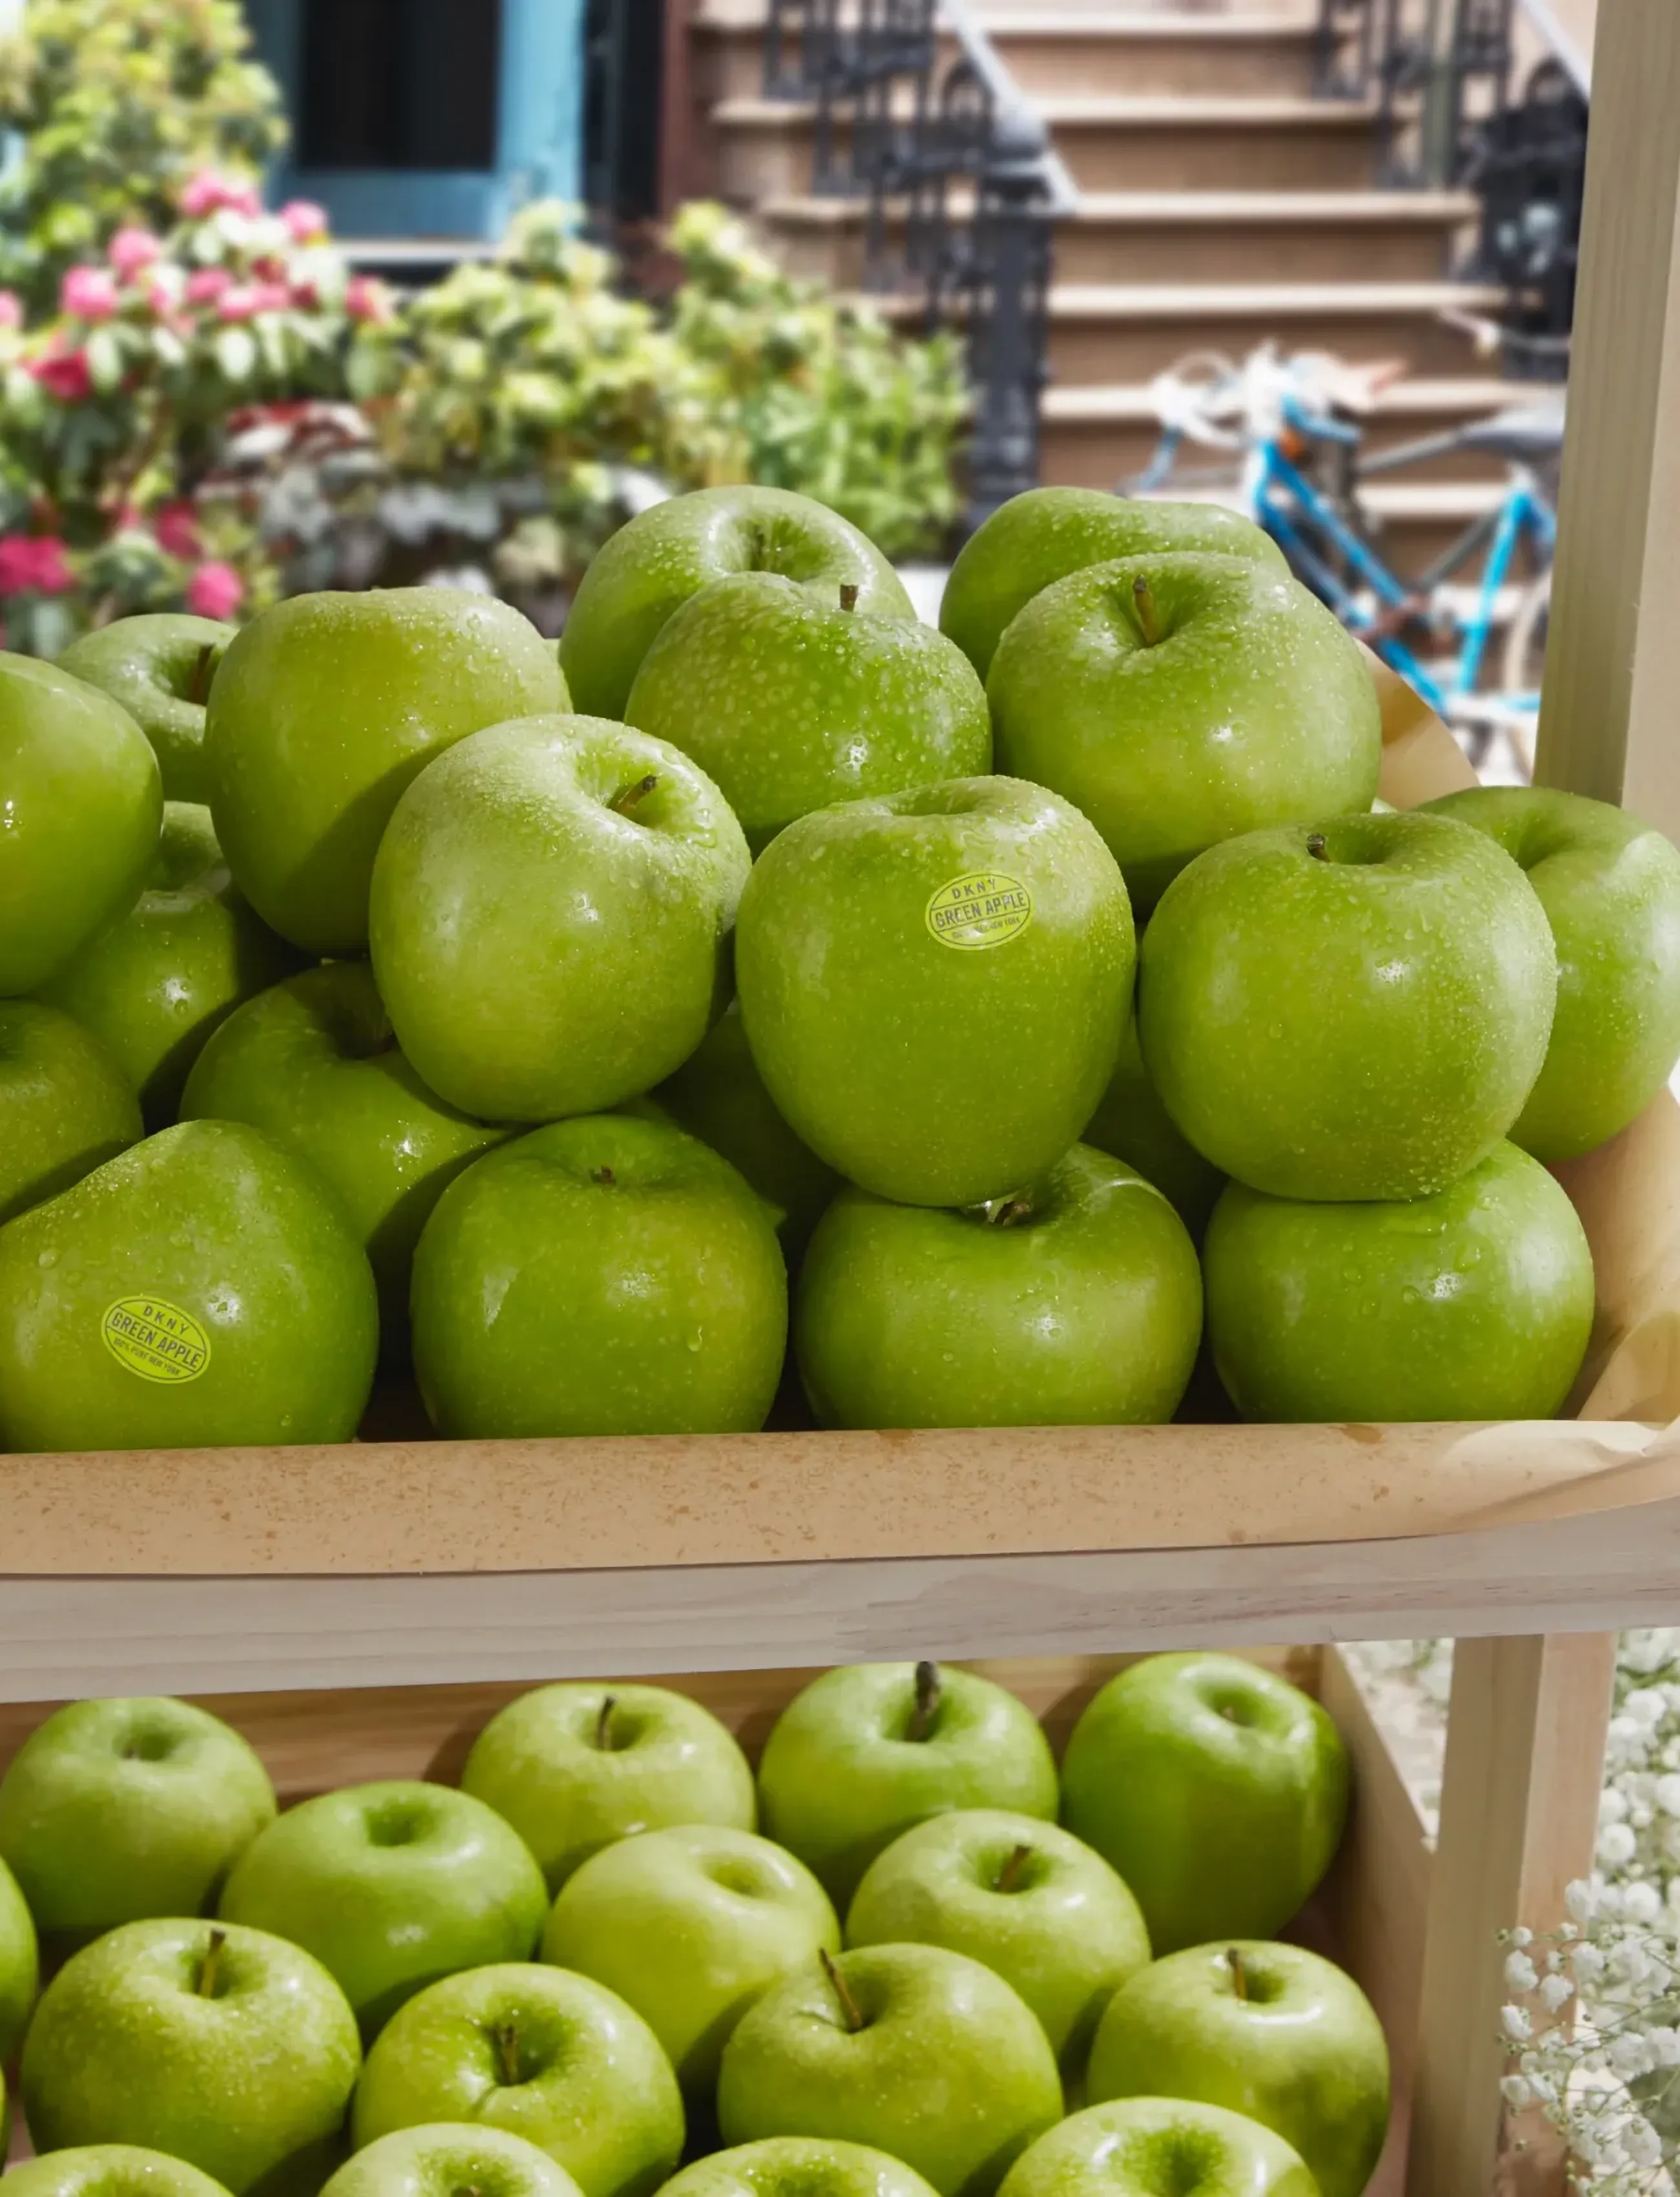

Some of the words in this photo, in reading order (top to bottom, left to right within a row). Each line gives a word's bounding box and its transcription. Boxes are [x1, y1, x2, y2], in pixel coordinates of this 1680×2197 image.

[952, 879, 996, 899] DKNY
[935, 903, 982, 927] GREEN
[985, 892, 1026, 915] APPLE
[143, 1304, 189, 1334] DKNY
[112, 1312, 158, 1345] GREEN
[156, 1337, 202, 1368] APPLE
